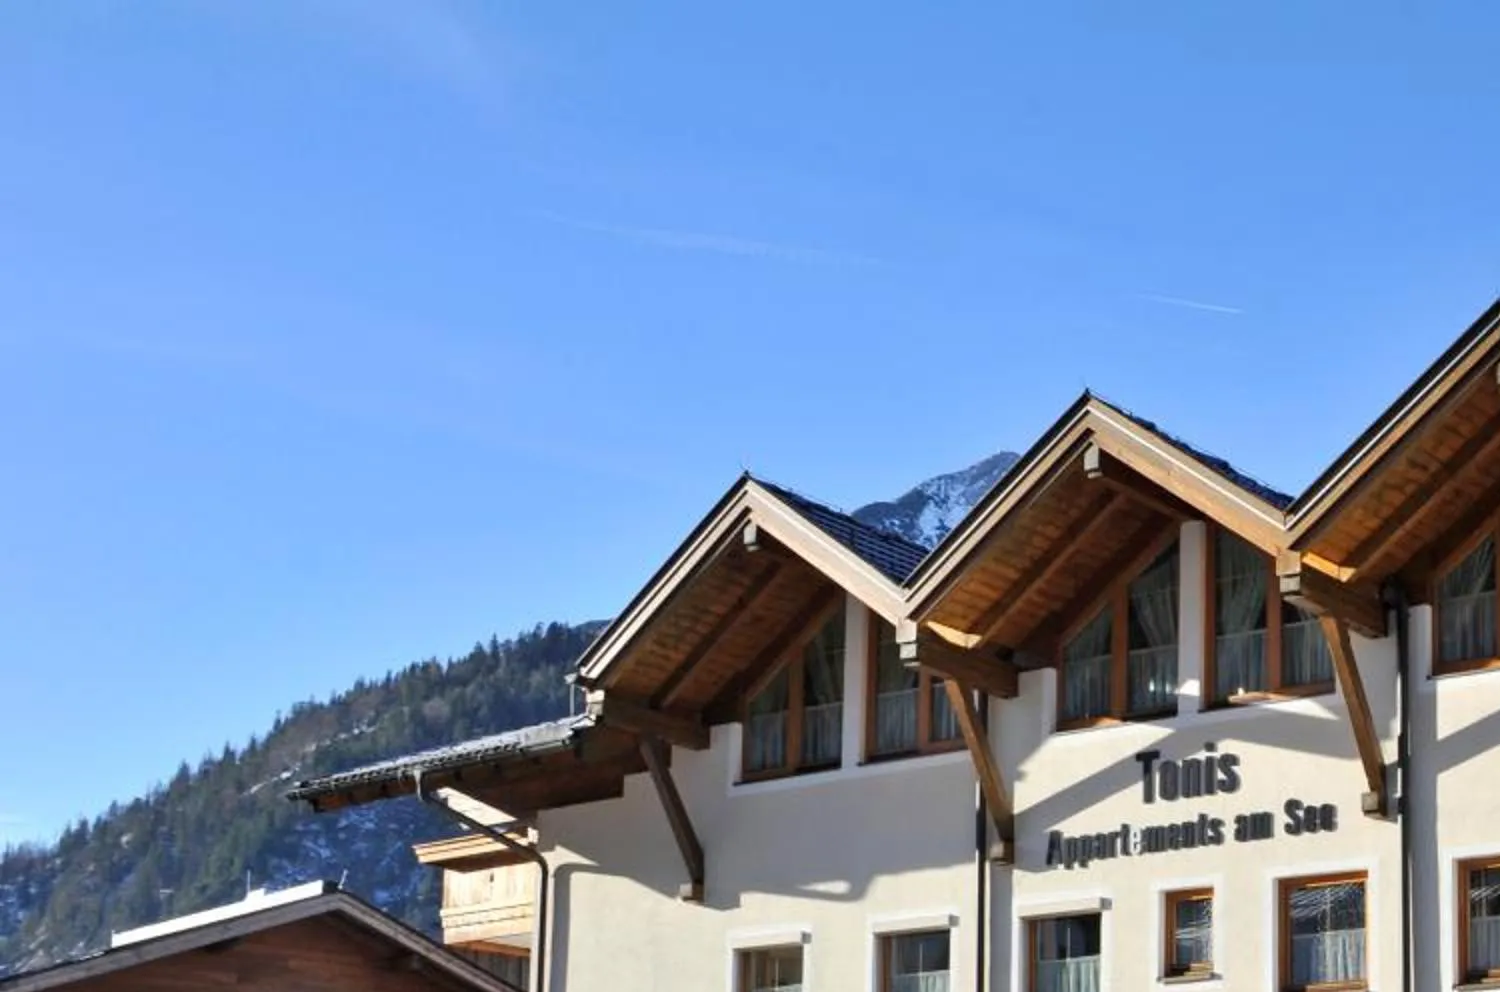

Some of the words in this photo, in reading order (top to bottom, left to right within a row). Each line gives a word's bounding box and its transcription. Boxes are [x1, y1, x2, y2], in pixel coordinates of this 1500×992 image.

[1135, 741, 1240, 804] Tonis
[1046, 813, 1225, 870] Appartements
[1234, 811, 1274, 842] am
[1284, 797, 1337, 836] See
